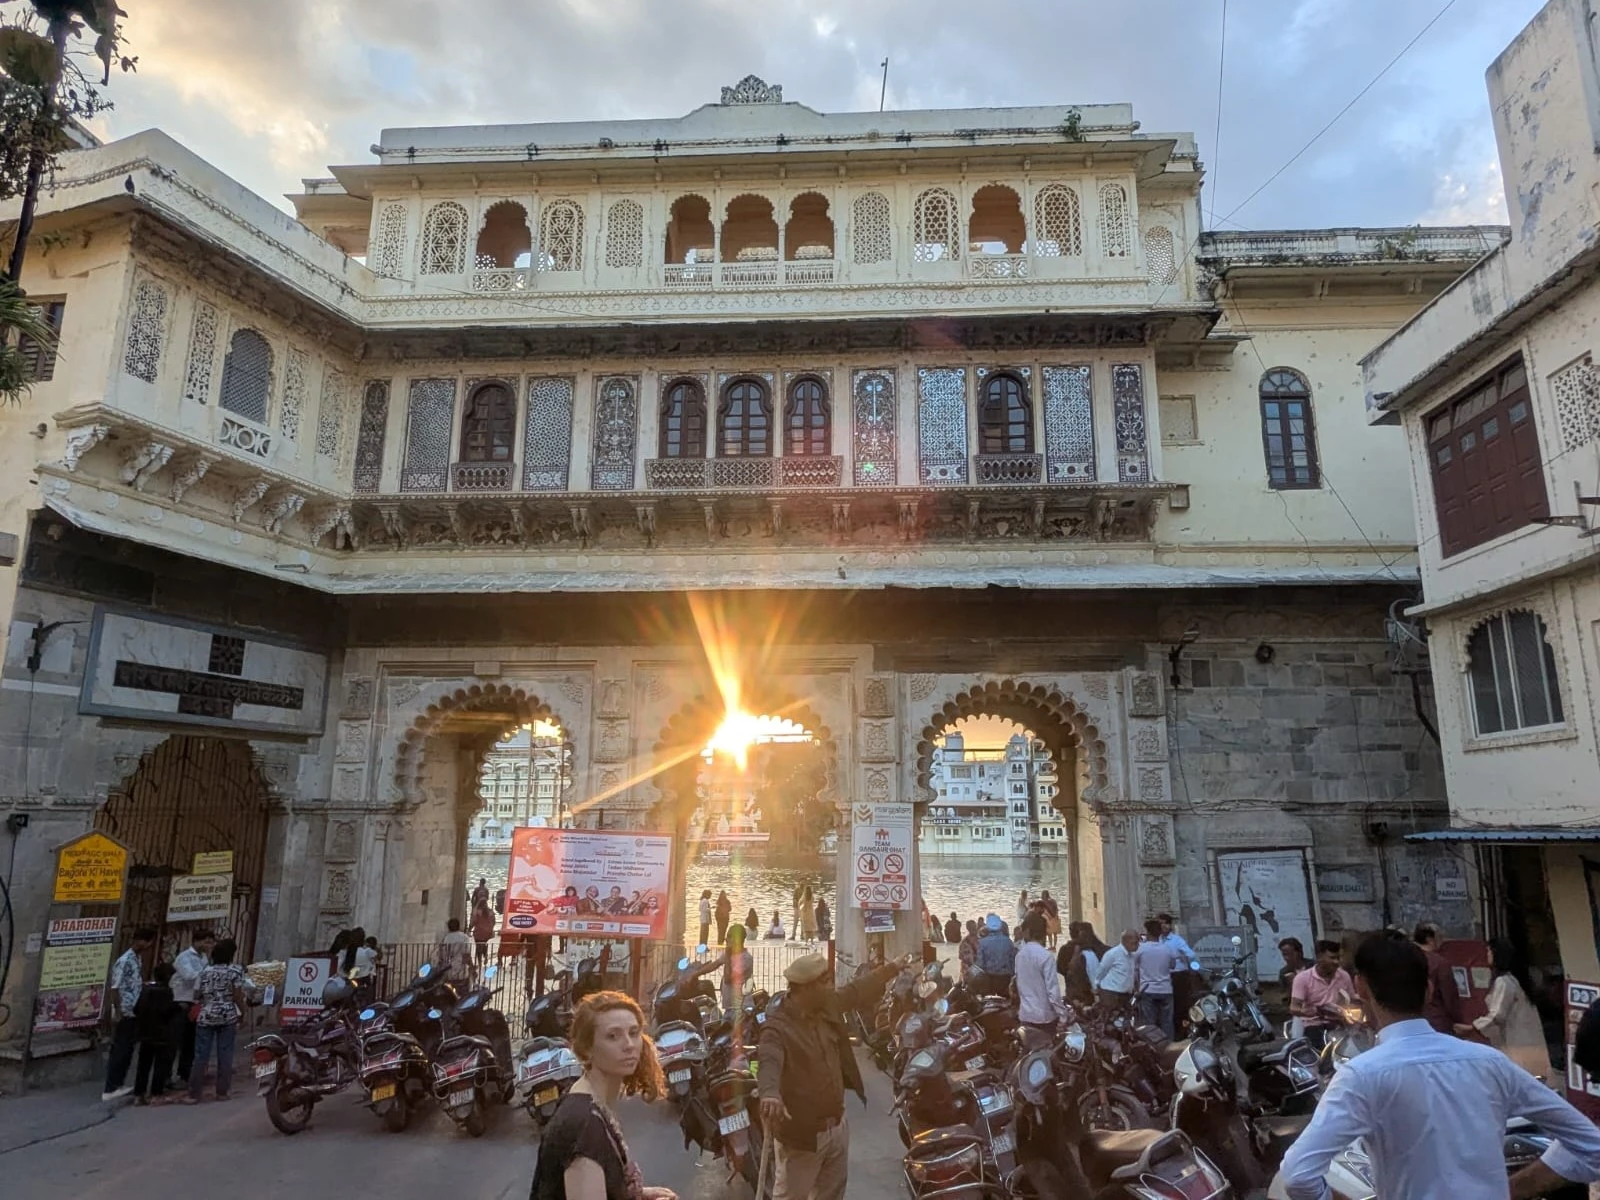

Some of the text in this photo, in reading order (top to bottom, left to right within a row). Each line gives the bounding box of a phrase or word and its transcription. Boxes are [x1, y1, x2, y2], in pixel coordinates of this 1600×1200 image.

[52, 918, 114, 933] DHAROHAR
[299, 987, 313, 996] NO
[284, 996, 325, 1005] PARKING
